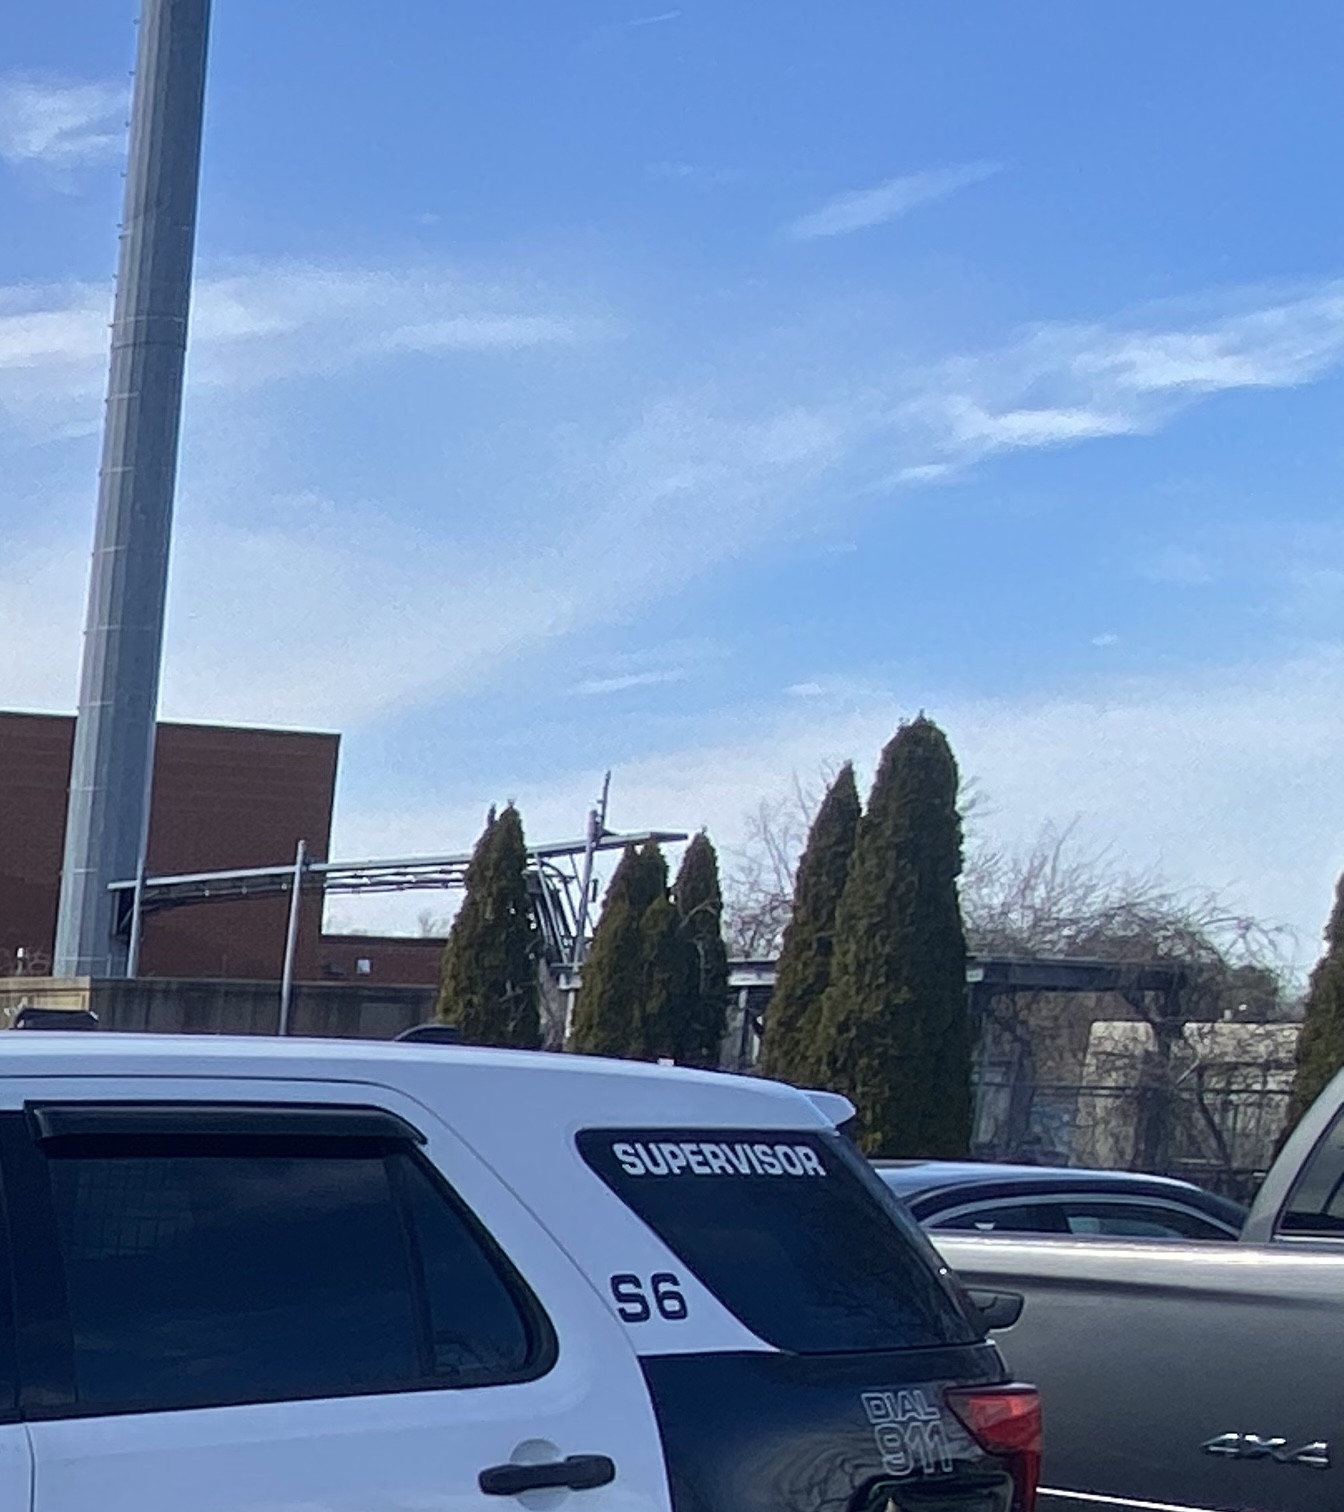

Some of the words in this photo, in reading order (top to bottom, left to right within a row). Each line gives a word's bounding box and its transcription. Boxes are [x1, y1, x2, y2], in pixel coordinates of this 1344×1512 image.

[612, 1142, 827, 1176] SUPERVISOR
[610, 1271, 688, 1323] S6
[860, 1389, 941, 1424] DIAL
[874, 1420, 954, 1476] 911
